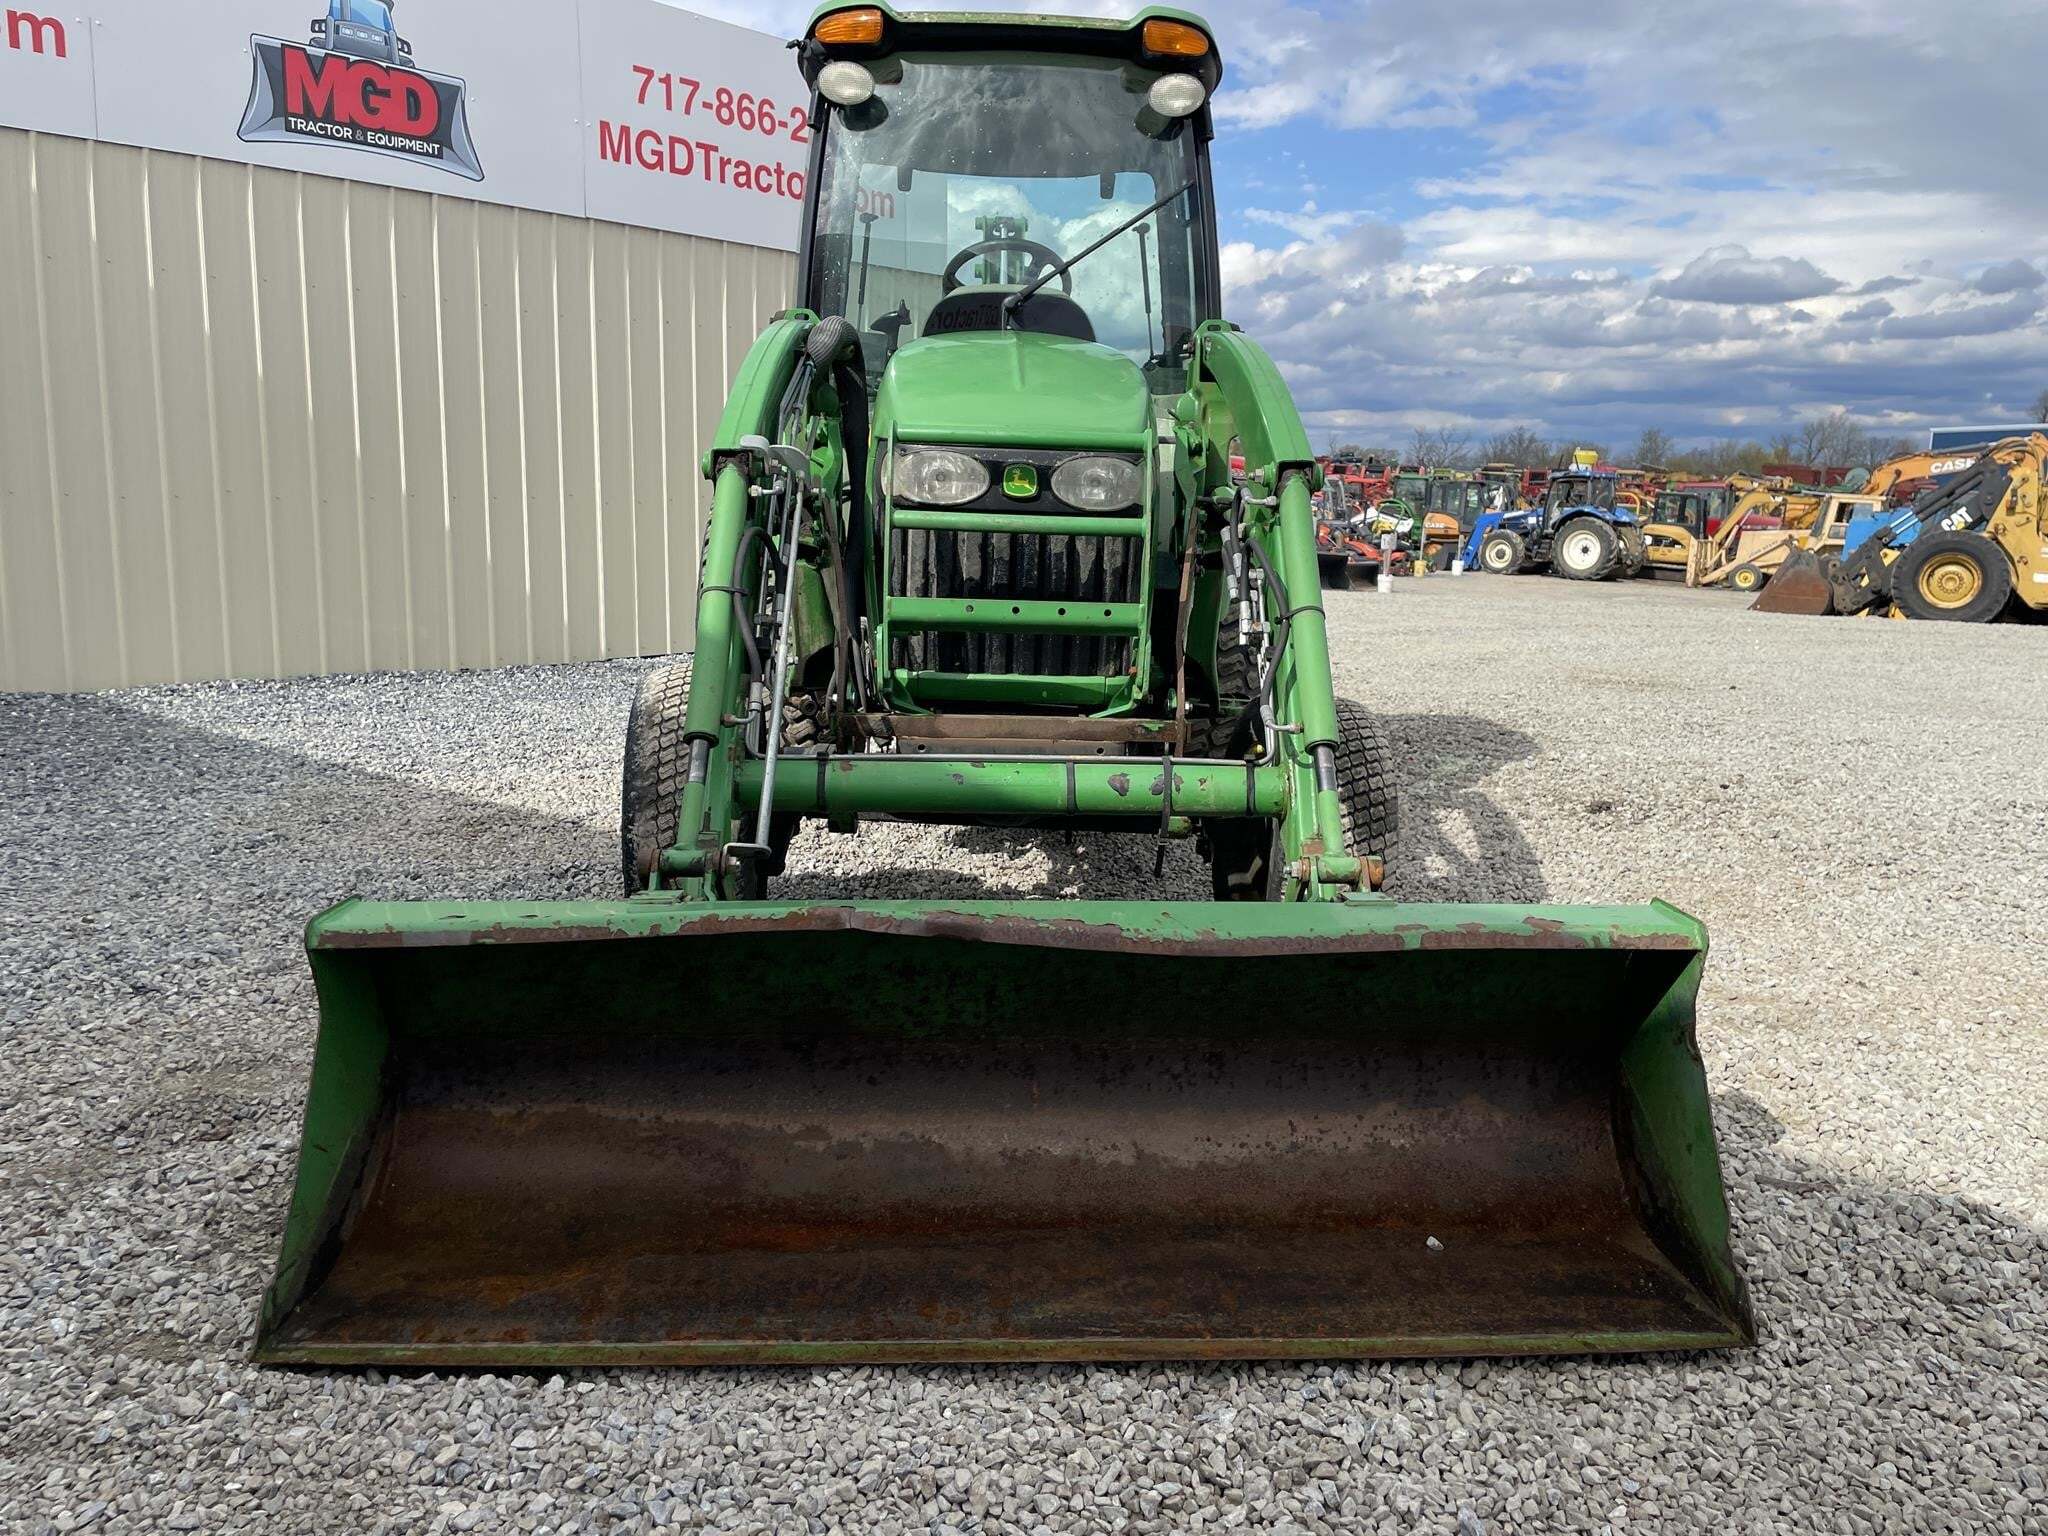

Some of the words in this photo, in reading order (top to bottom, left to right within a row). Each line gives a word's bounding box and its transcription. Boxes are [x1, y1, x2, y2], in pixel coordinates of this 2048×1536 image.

[0, 10, 67, 58] m
[284, 46, 439, 137] MGD
[632, 64, 808, 143] 717-866-2
[287, 116, 353, 140] TRACTOR
[355, 129, 364, 141] &
[367, 131, 440, 155] EQUIPMENT
[599, 120, 805, 201] MGDTracto
[1941, 506, 1973, 531] CAT
